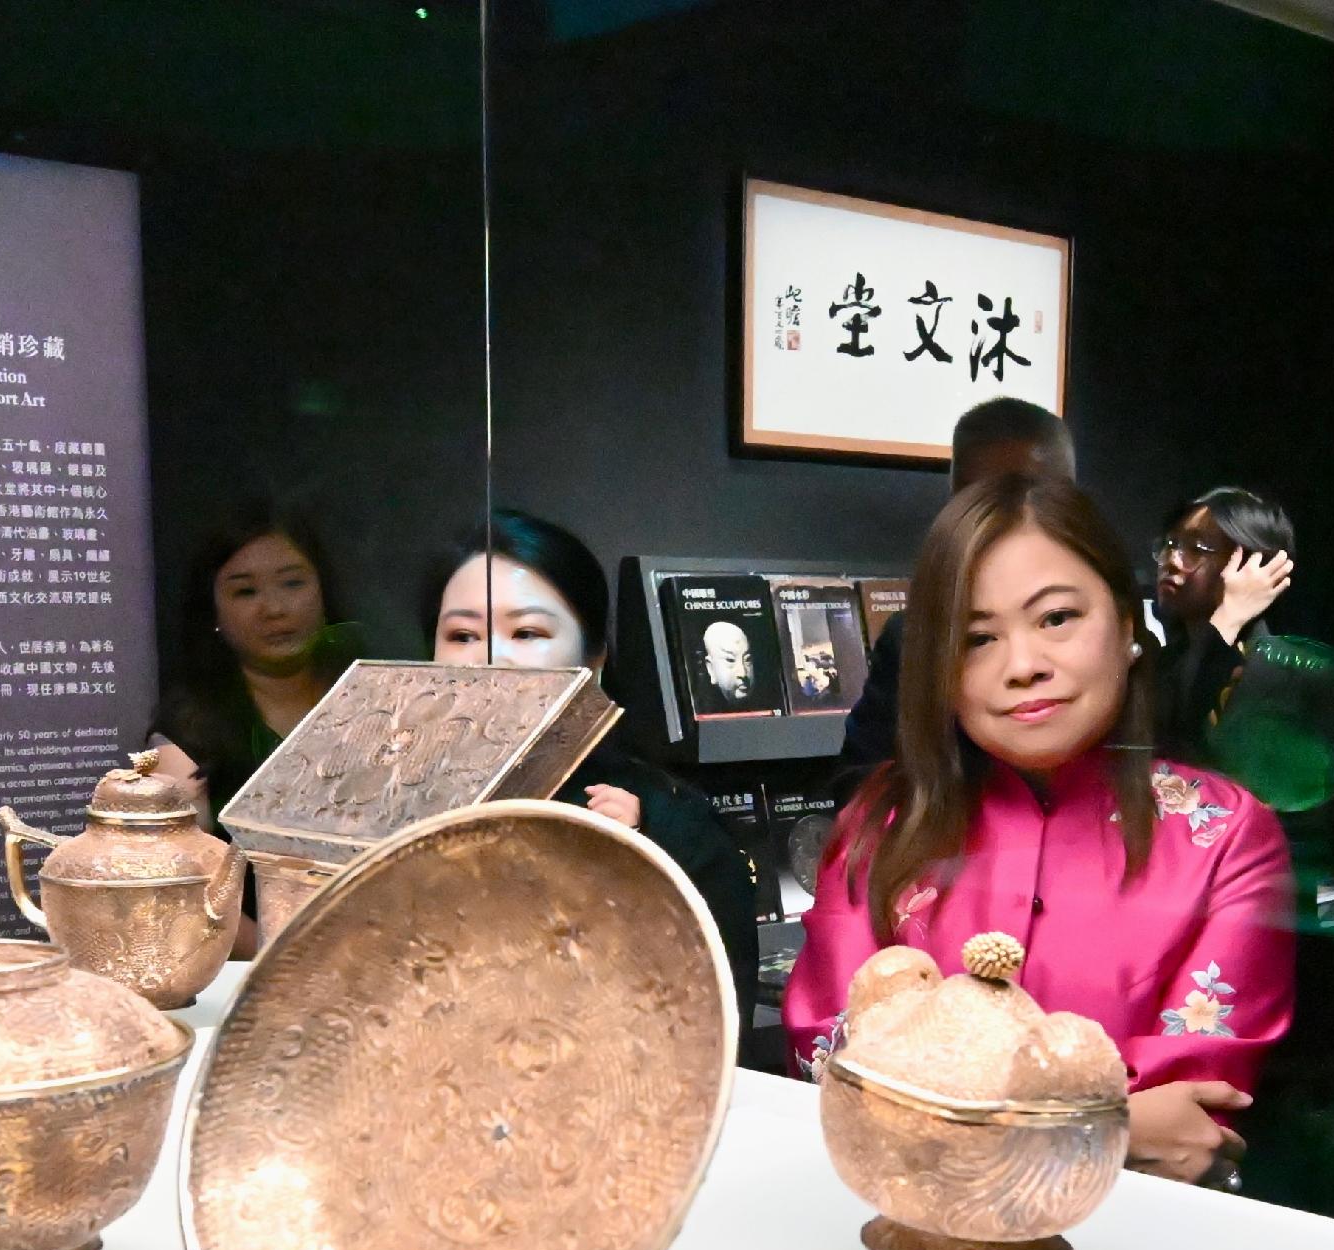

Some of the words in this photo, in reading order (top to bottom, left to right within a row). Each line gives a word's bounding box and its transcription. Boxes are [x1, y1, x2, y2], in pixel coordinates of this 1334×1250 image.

[20, 392, 45, 408] Art
[684, 601, 715, 610] CHINESE
[715, 599, 762, 610] SCULPTURES
[33, 731, 58, 741] years
[73, 726, 118, 736] dedicated
